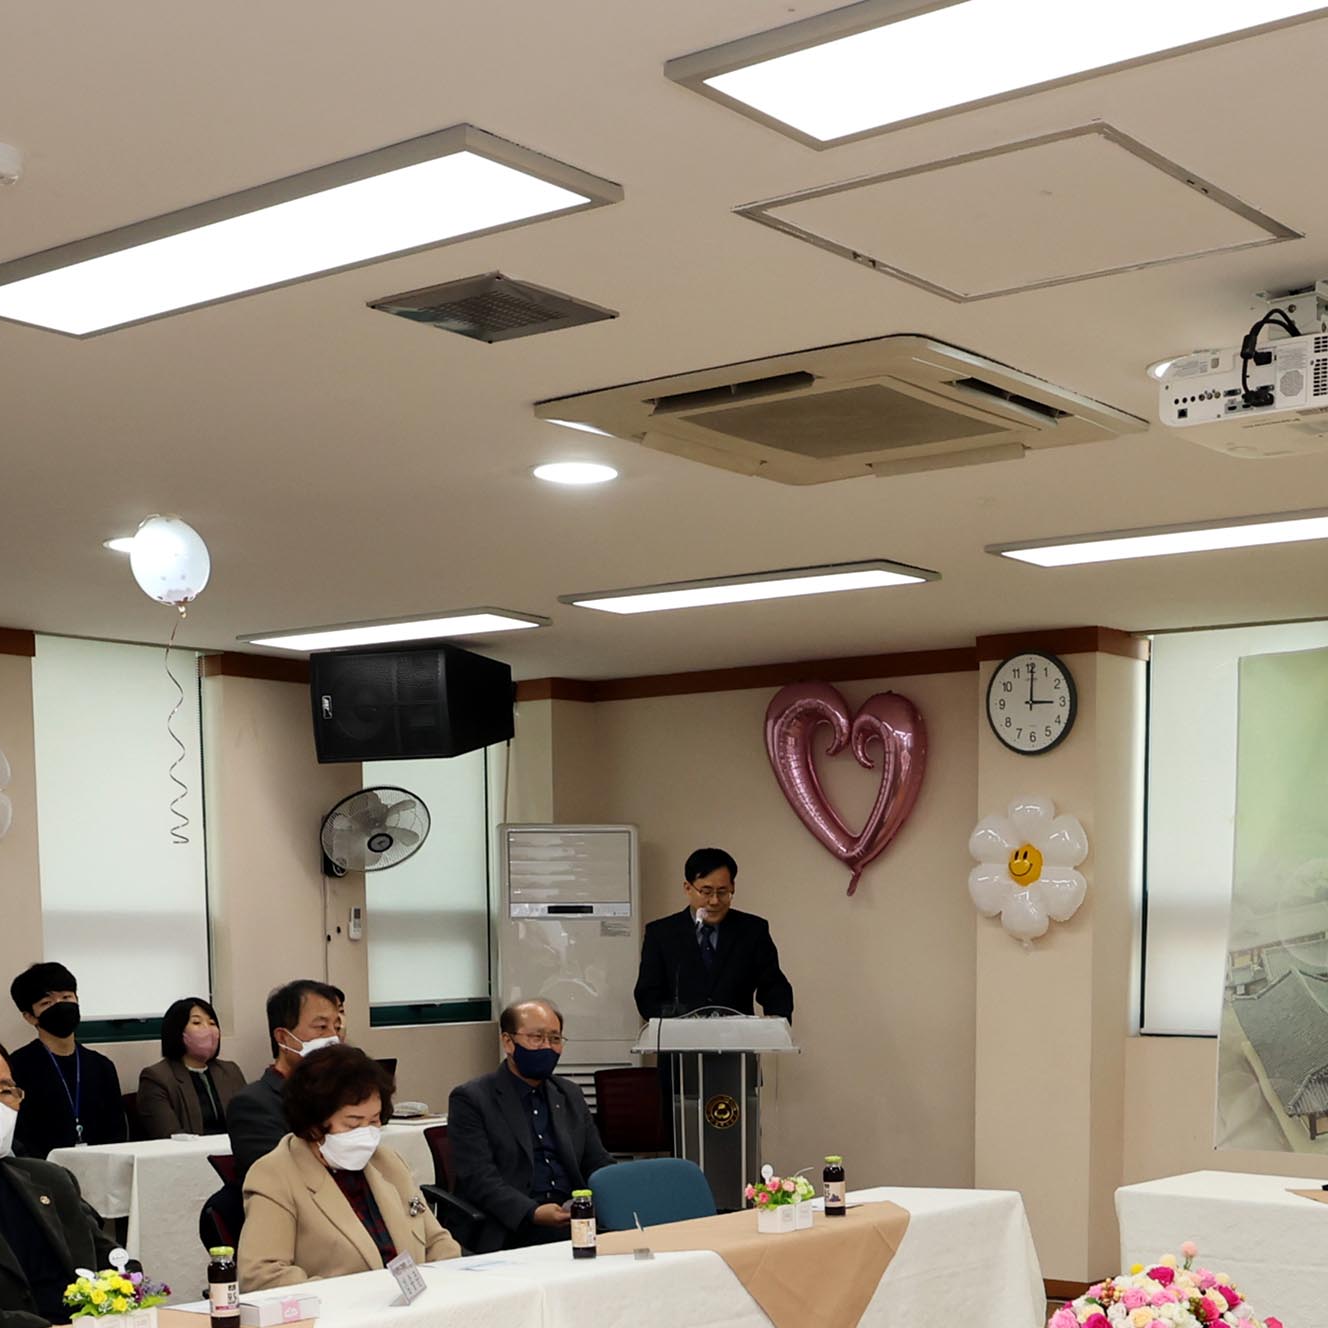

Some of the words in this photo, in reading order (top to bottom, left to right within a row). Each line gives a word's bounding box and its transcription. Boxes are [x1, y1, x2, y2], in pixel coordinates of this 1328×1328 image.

[1012, 668, 1020, 679] 11
[1002, 681, 1012, 692] 10
[1054, 678, 1061, 689] 2
[999, 699, 1006, 710] 9
[1059, 696, 1066, 707] 3
[1005, 717, 1012, 728] 8
[1054, 715, 1062, 725] 4
[1016, 728, 1023, 739] 7
[1029, 731, 1037, 742] 6
[1045, 726, 1052, 737] 5
